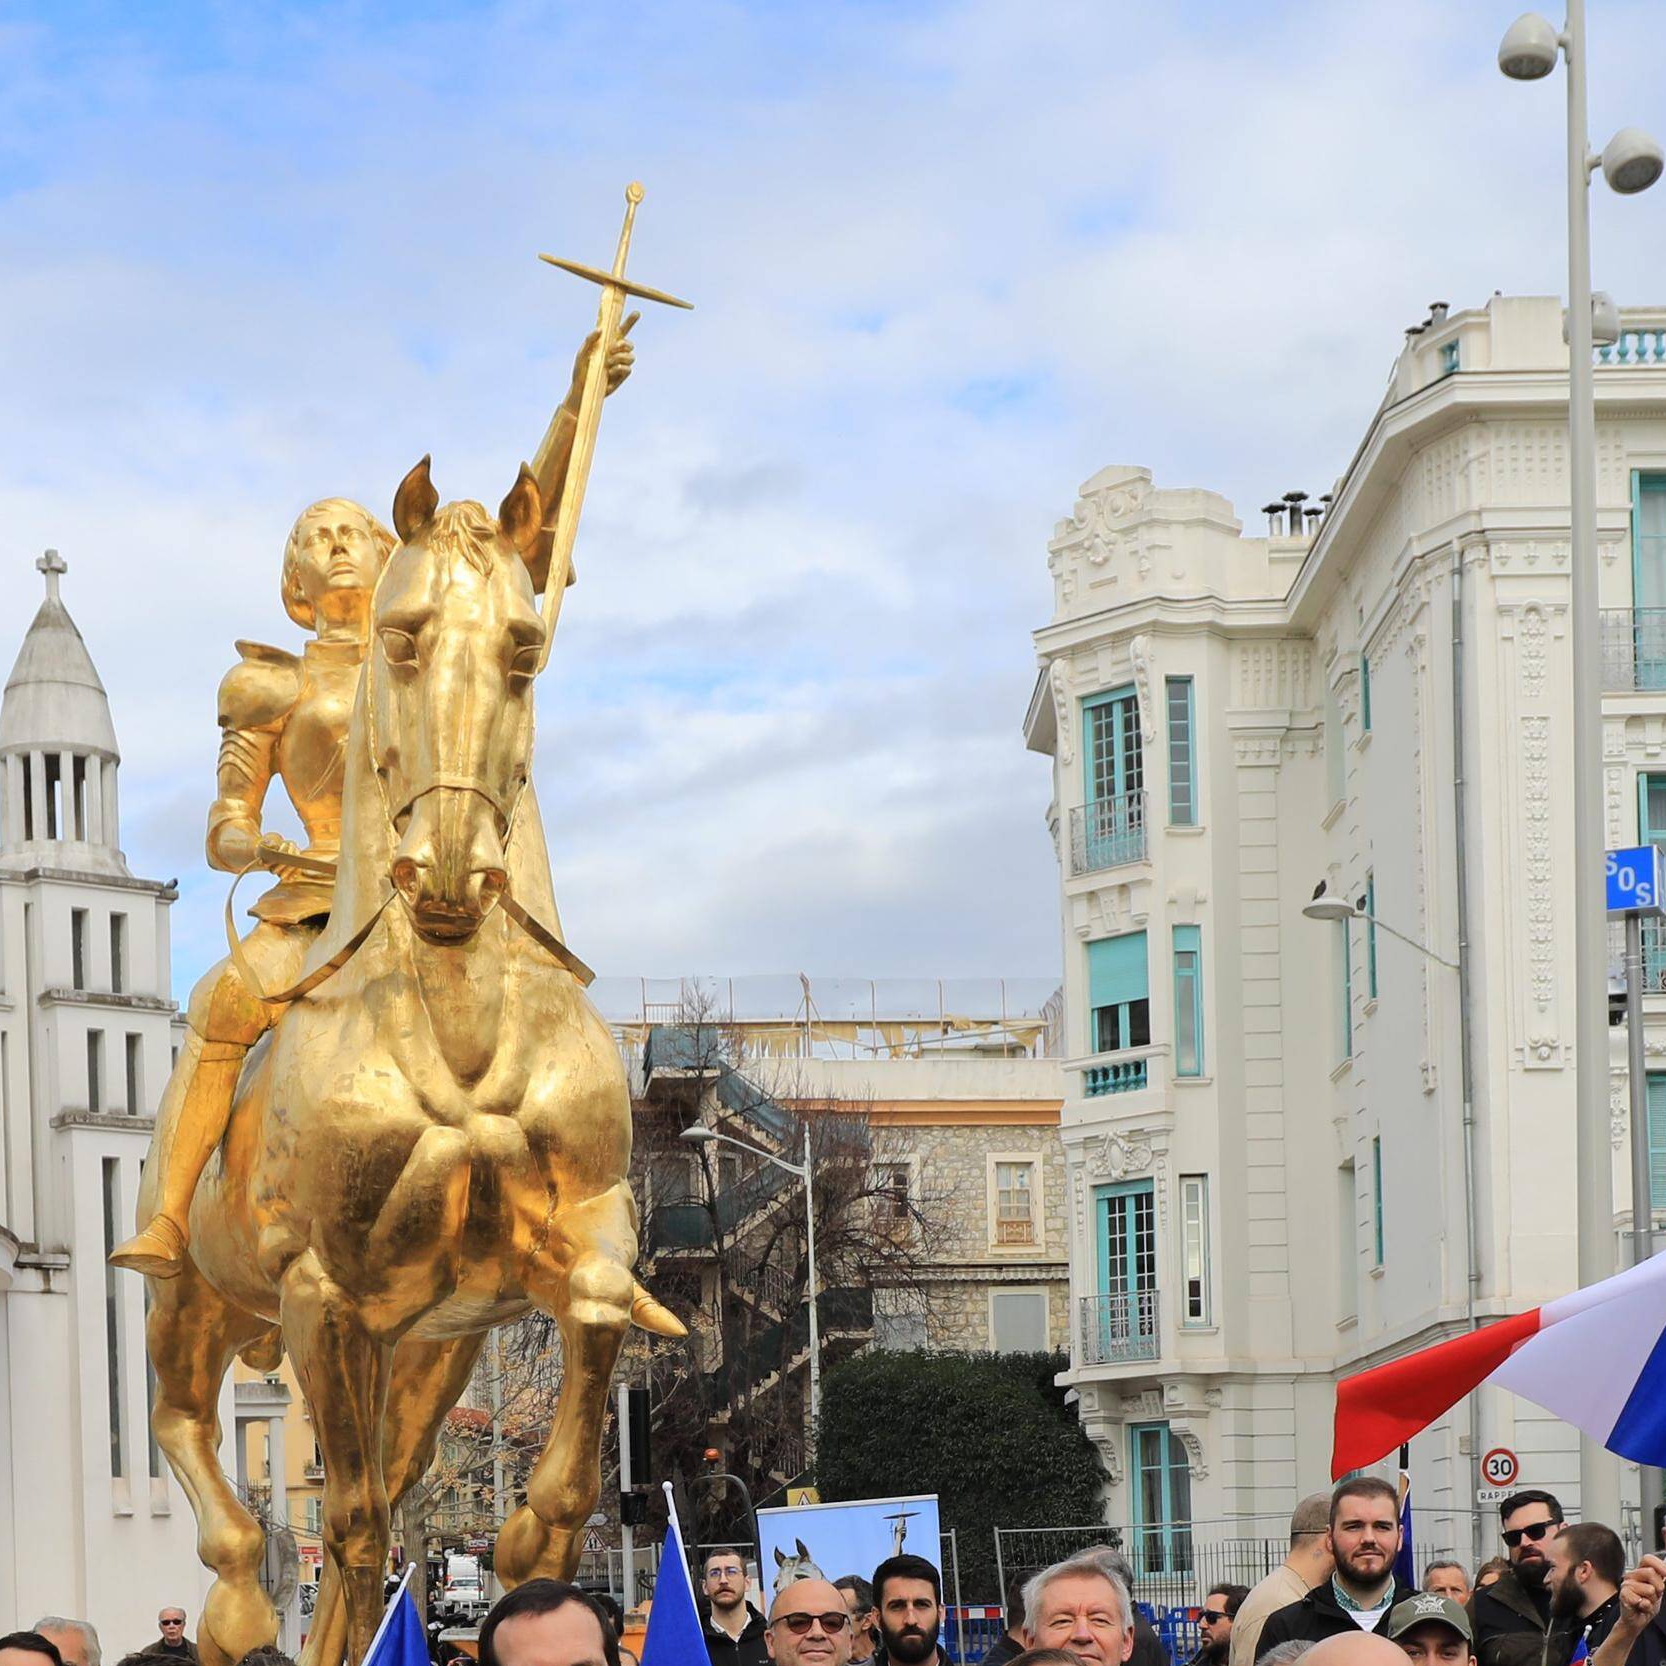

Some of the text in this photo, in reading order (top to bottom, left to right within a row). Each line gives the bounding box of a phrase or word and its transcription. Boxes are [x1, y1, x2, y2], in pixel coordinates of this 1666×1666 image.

[1605, 852, 1652, 906] SOS
[1489, 1459, 1512, 1476] 30
[1480, 1490, 1517, 1500] RAPPE
